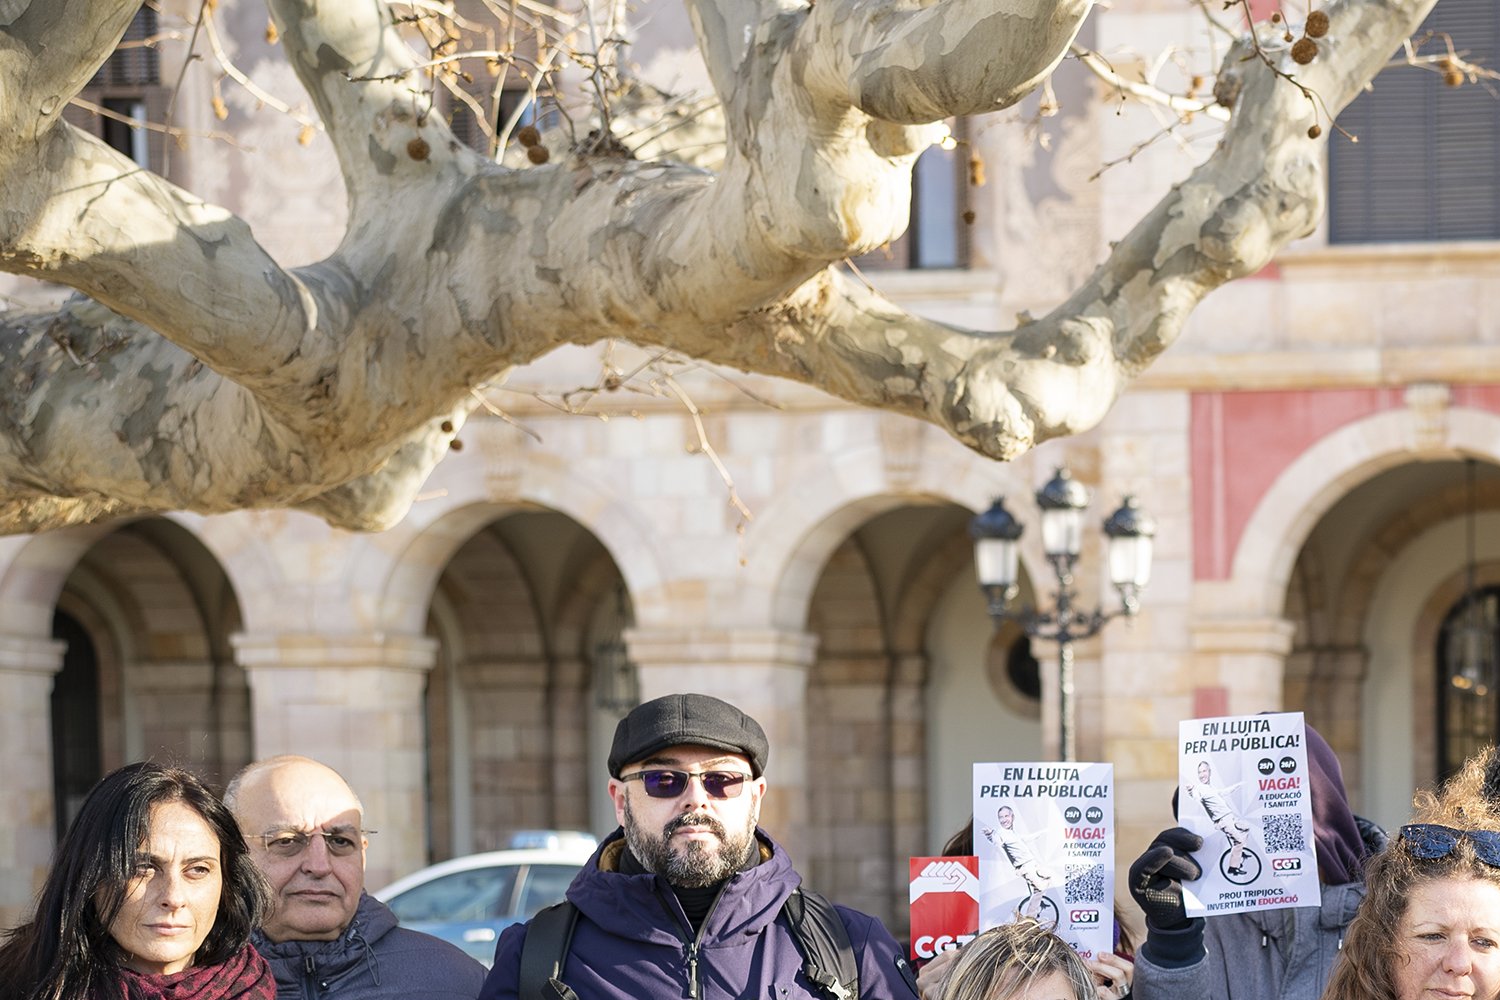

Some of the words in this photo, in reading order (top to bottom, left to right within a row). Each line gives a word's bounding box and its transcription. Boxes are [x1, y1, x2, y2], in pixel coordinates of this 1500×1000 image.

[1203, 723, 1218, 736] EN
[1222, 720, 1270, 735] LLUITA
[1185, 741, 1207, 754] PER
[1211, 739, 1227, 752] LA
[1231, 734, 1300, 751] PÚBLICA!
[1004, 768, 1023, 780] EN
[1028, 768, 1079, 780] LLUITA
[980, 785, 1010, 798] PER
[1014, 785, 1033, 798] LA
[1037, 781, 1108, 798] PÚBLICA!
[1259, 778, 1300, 791] VAGA!
[1266, 792, 1301, 800] EDUCACIÓ
[1065, 828, 1105, 839] VAGA!
[1070, 841, 1105, 849] EDUCACIÓ
[1274, 859, 1300, 869] CGT
[1219, 892, 1242, 900] PROU
[1244, 888, 1283, 899] TRIPIJOCS
[1207, 900, 1244, 911] INVERTIM
[1258, 895, 1298, 905] EDUCACIÓ
[1072, 912, 1097, 921] CGT
